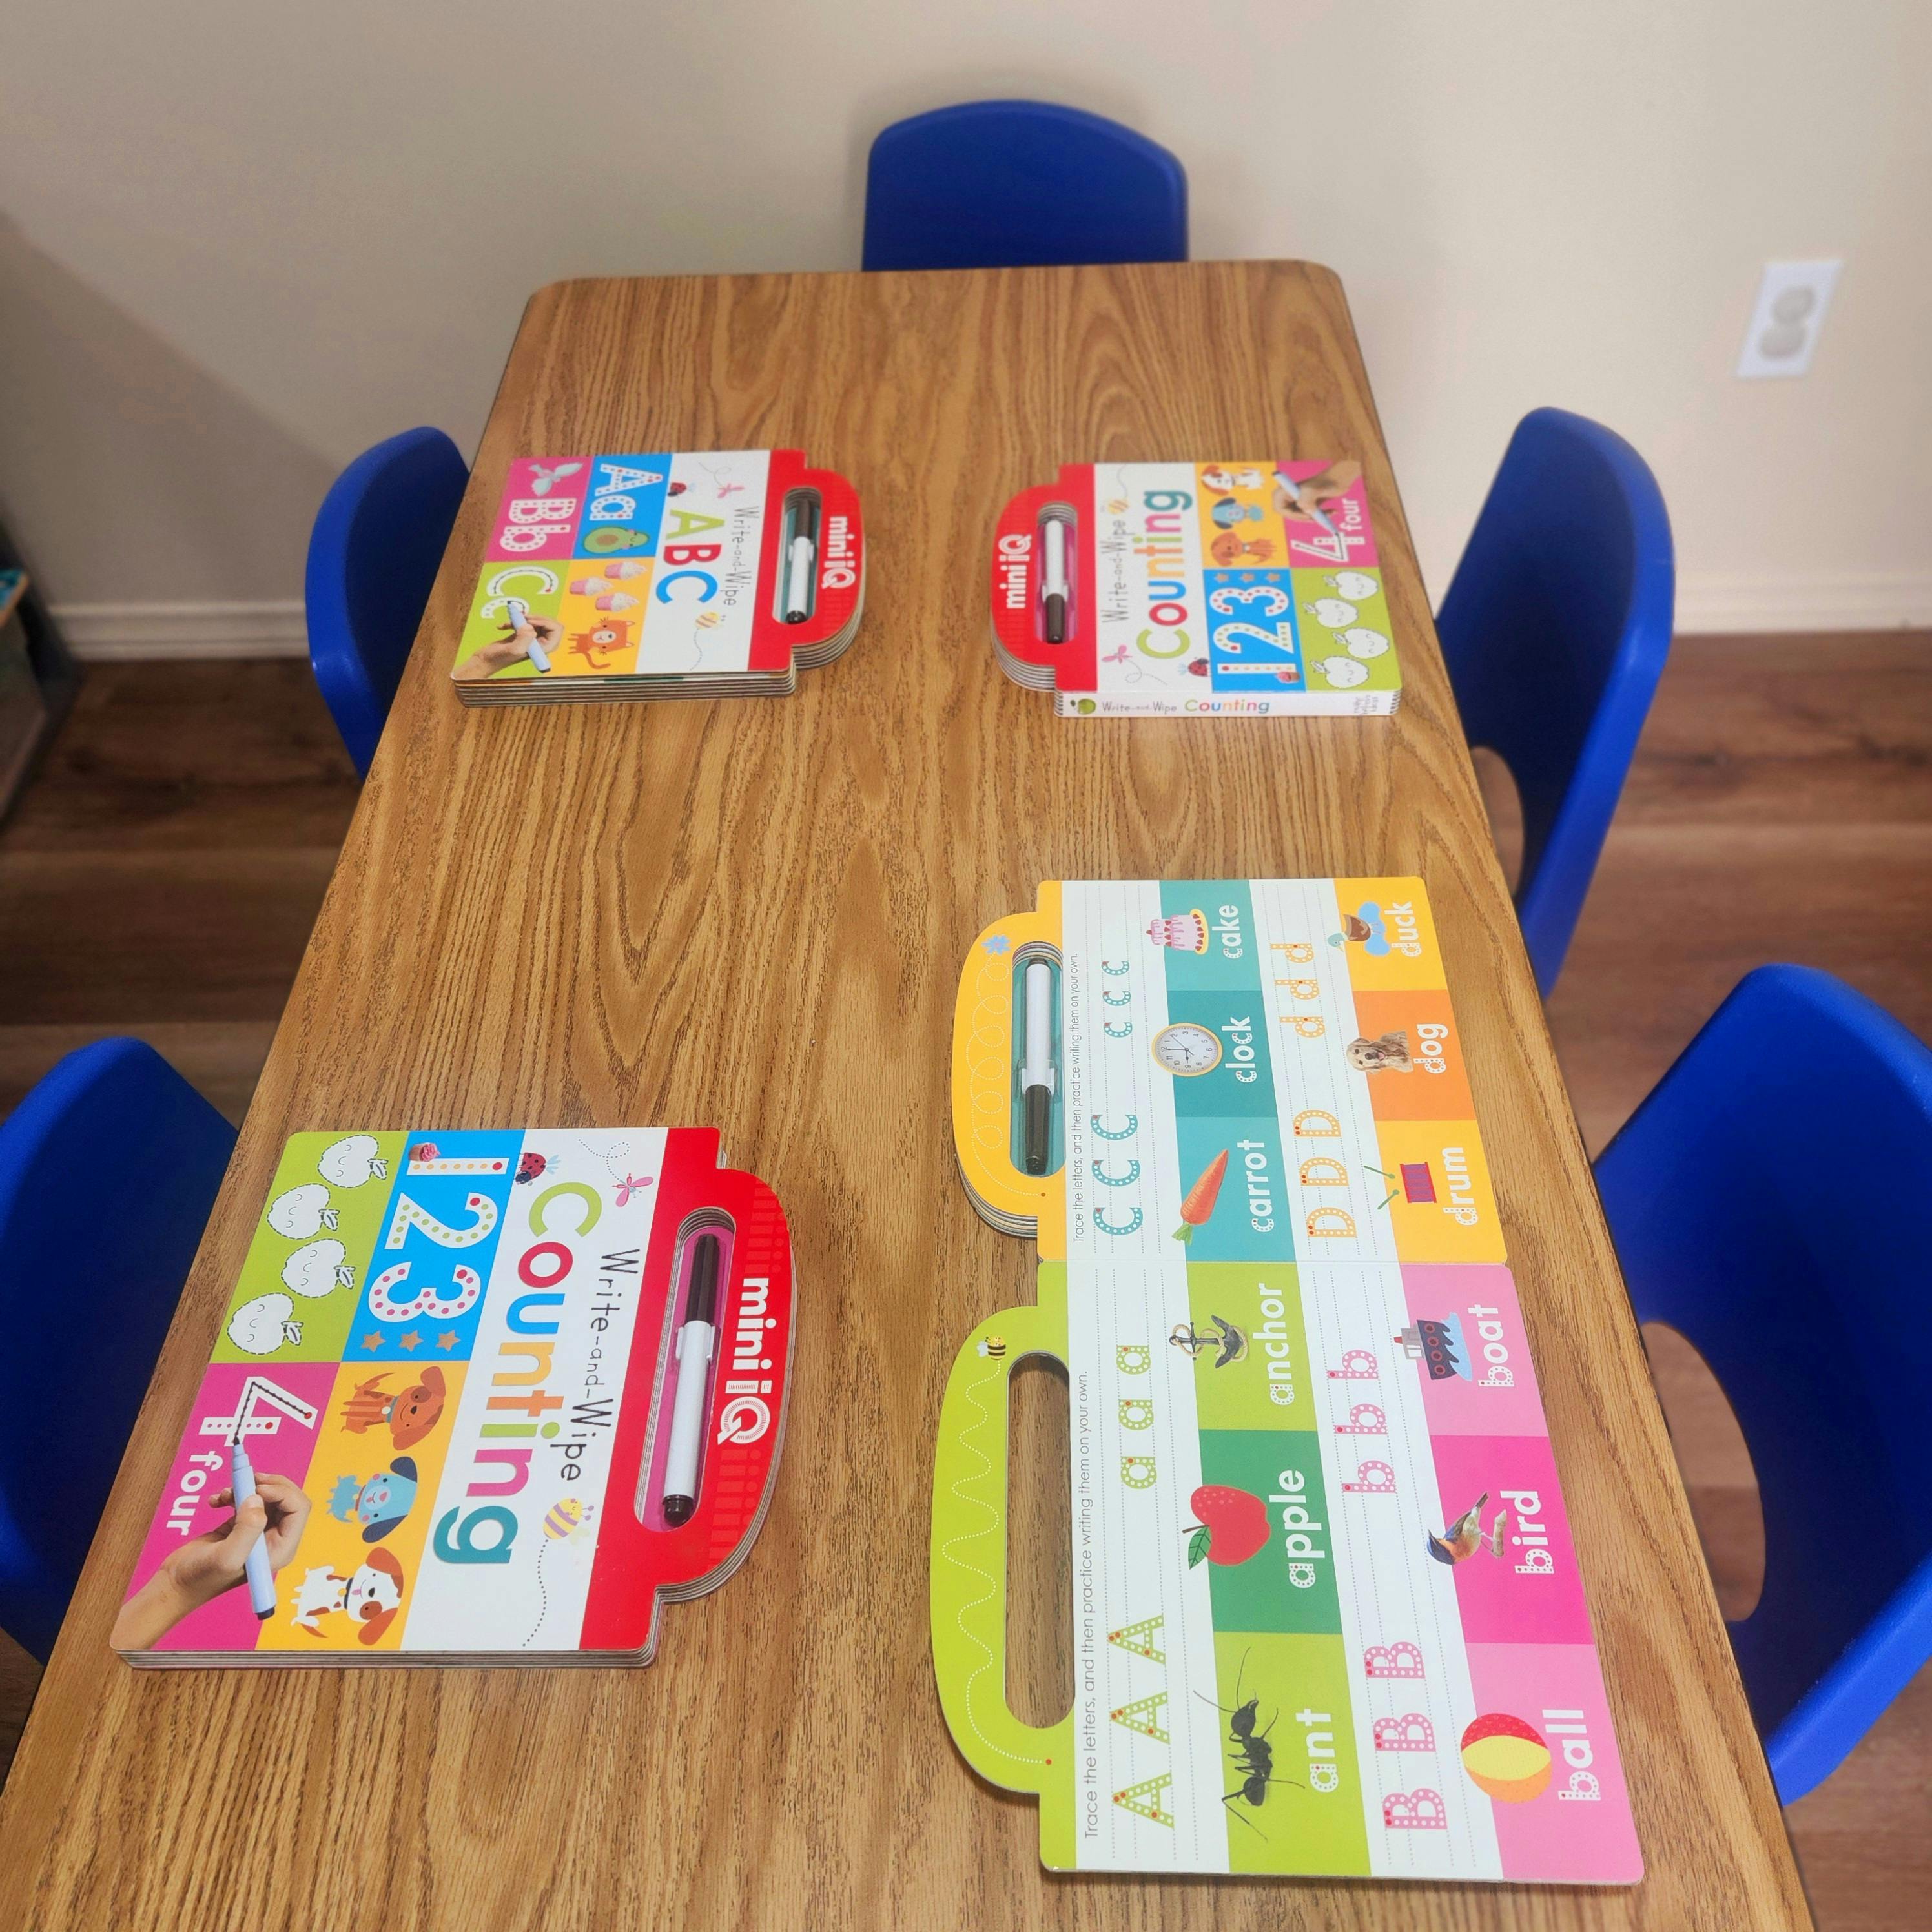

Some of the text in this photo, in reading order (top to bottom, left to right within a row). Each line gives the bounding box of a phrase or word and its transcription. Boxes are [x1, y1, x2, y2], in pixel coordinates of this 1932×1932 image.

[721, 506, 760, 606] Write-and-Wipe
[1291, 531, 1365, 562] 4
[1339, 498, 1362, 531] four
[1100, 520, 1136, 622] Write-and-Wipe
[1133, 490, 1193, 659] Counting
[1184, 699, 1271, 714] Counting
[1211, 905, 1243, 959] cake
[1384, 901, 1423, 957] duck
[1221, 1016, 1257, 1084] clock
[1269, 943, 1357, 1238] D D D d d d
[1413, 1023, 1449, 1074] dog
[1069, 952, 1084, 1244] Trace the letters, and then practice writing them on your own.
[1237, 1139, 1275, 1233] carrot
[1441, 1147, 1479, 1226] drum
[433, 1181, 602, 1564] Counting
[550, 1248, 641, 1482] Write-and-Wipe
[1252, 1282, 1295, 1406] anchor
[1467, 1304, 1515, 1388] boat
[198, 1376, 319, 1447] 4
[165, 1450, 224, 1536] four
[1268, 1469, 1326, 1589] apple
[1499, 1490, 1555, 1575] bird
[1078, 1370, 1098, 1840] Trace the letters, and then practice writing them on your own.
[1106, 1344, 1175, 1829] A A A a a a
[1327, 1349, 1448, 1830] B B B b b b
[1295, 1708, 1339, 1793] ant
[1542, 1709, 1602, 1802] ball
